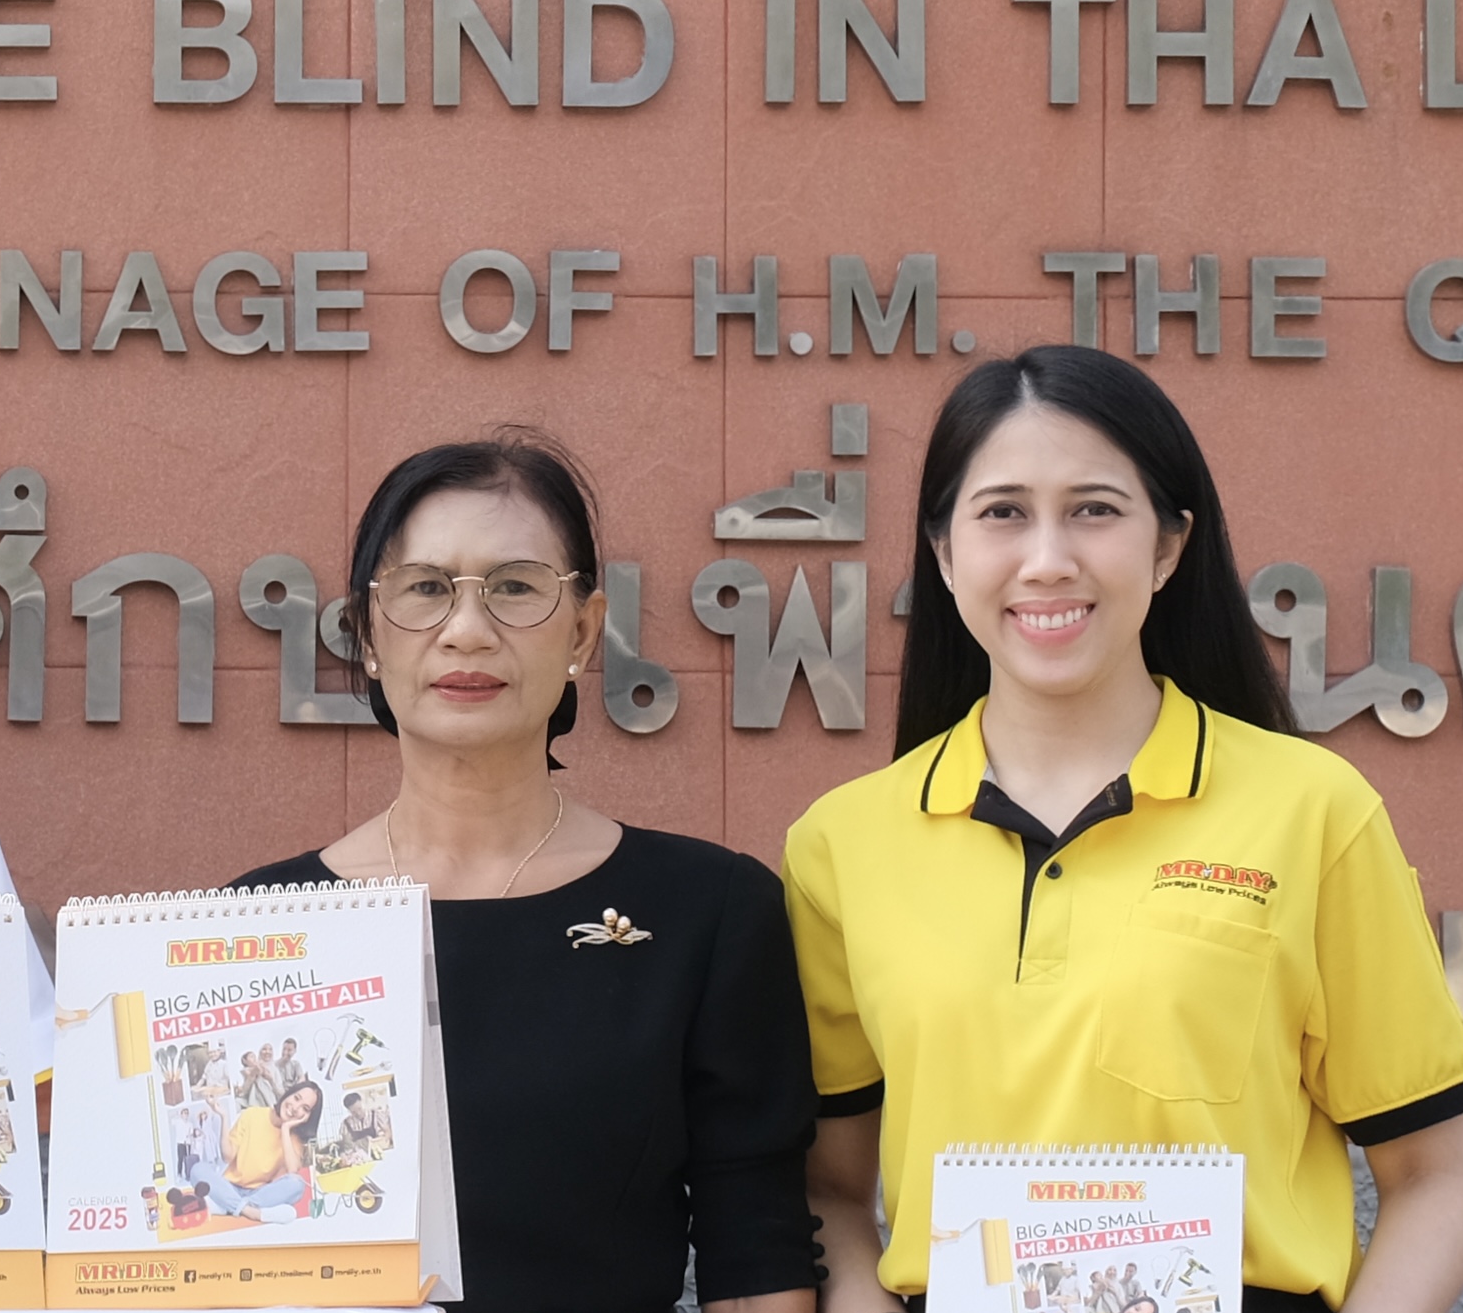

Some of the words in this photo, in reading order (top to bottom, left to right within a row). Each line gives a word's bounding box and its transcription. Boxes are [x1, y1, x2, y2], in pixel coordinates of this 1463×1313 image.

[439, 248, 620, 353] OF
[693, 253, 977, 356] H.M.
[1042, 250, 1327, 360] THE
[153, 995, 190, 1018] BIG
[195, 984, 243, 1010] AND
[248, 969, 323, 999] SMALL
[159, 1009, 257, 1040] MR.D.I.Y.
[259, 996, 306, 1019] HAS
[309, 990, 332, 1011] IT
[337, 981, 380, 1004] ALL
[67, 1207, 128, 1231] 2025
[1016, 1224, 1047, 1240] BIG
[1052, 1218, 1092, 1235] AND
[1097, 1210, 1160, 1230] SMALL
[1020, 1236, 1103, 1257] MR.D.I.Y.
[1105, 1229, 1144, 1247] HAS
[1148, 1225, 1167, 1240] IT
[1172, 1220, 1209, 1237] ALL
[76, 1285, 116, 1296] Always
[117, 1286, 140, 1294] Low
[141, 1284, 175, 1293] Prices
